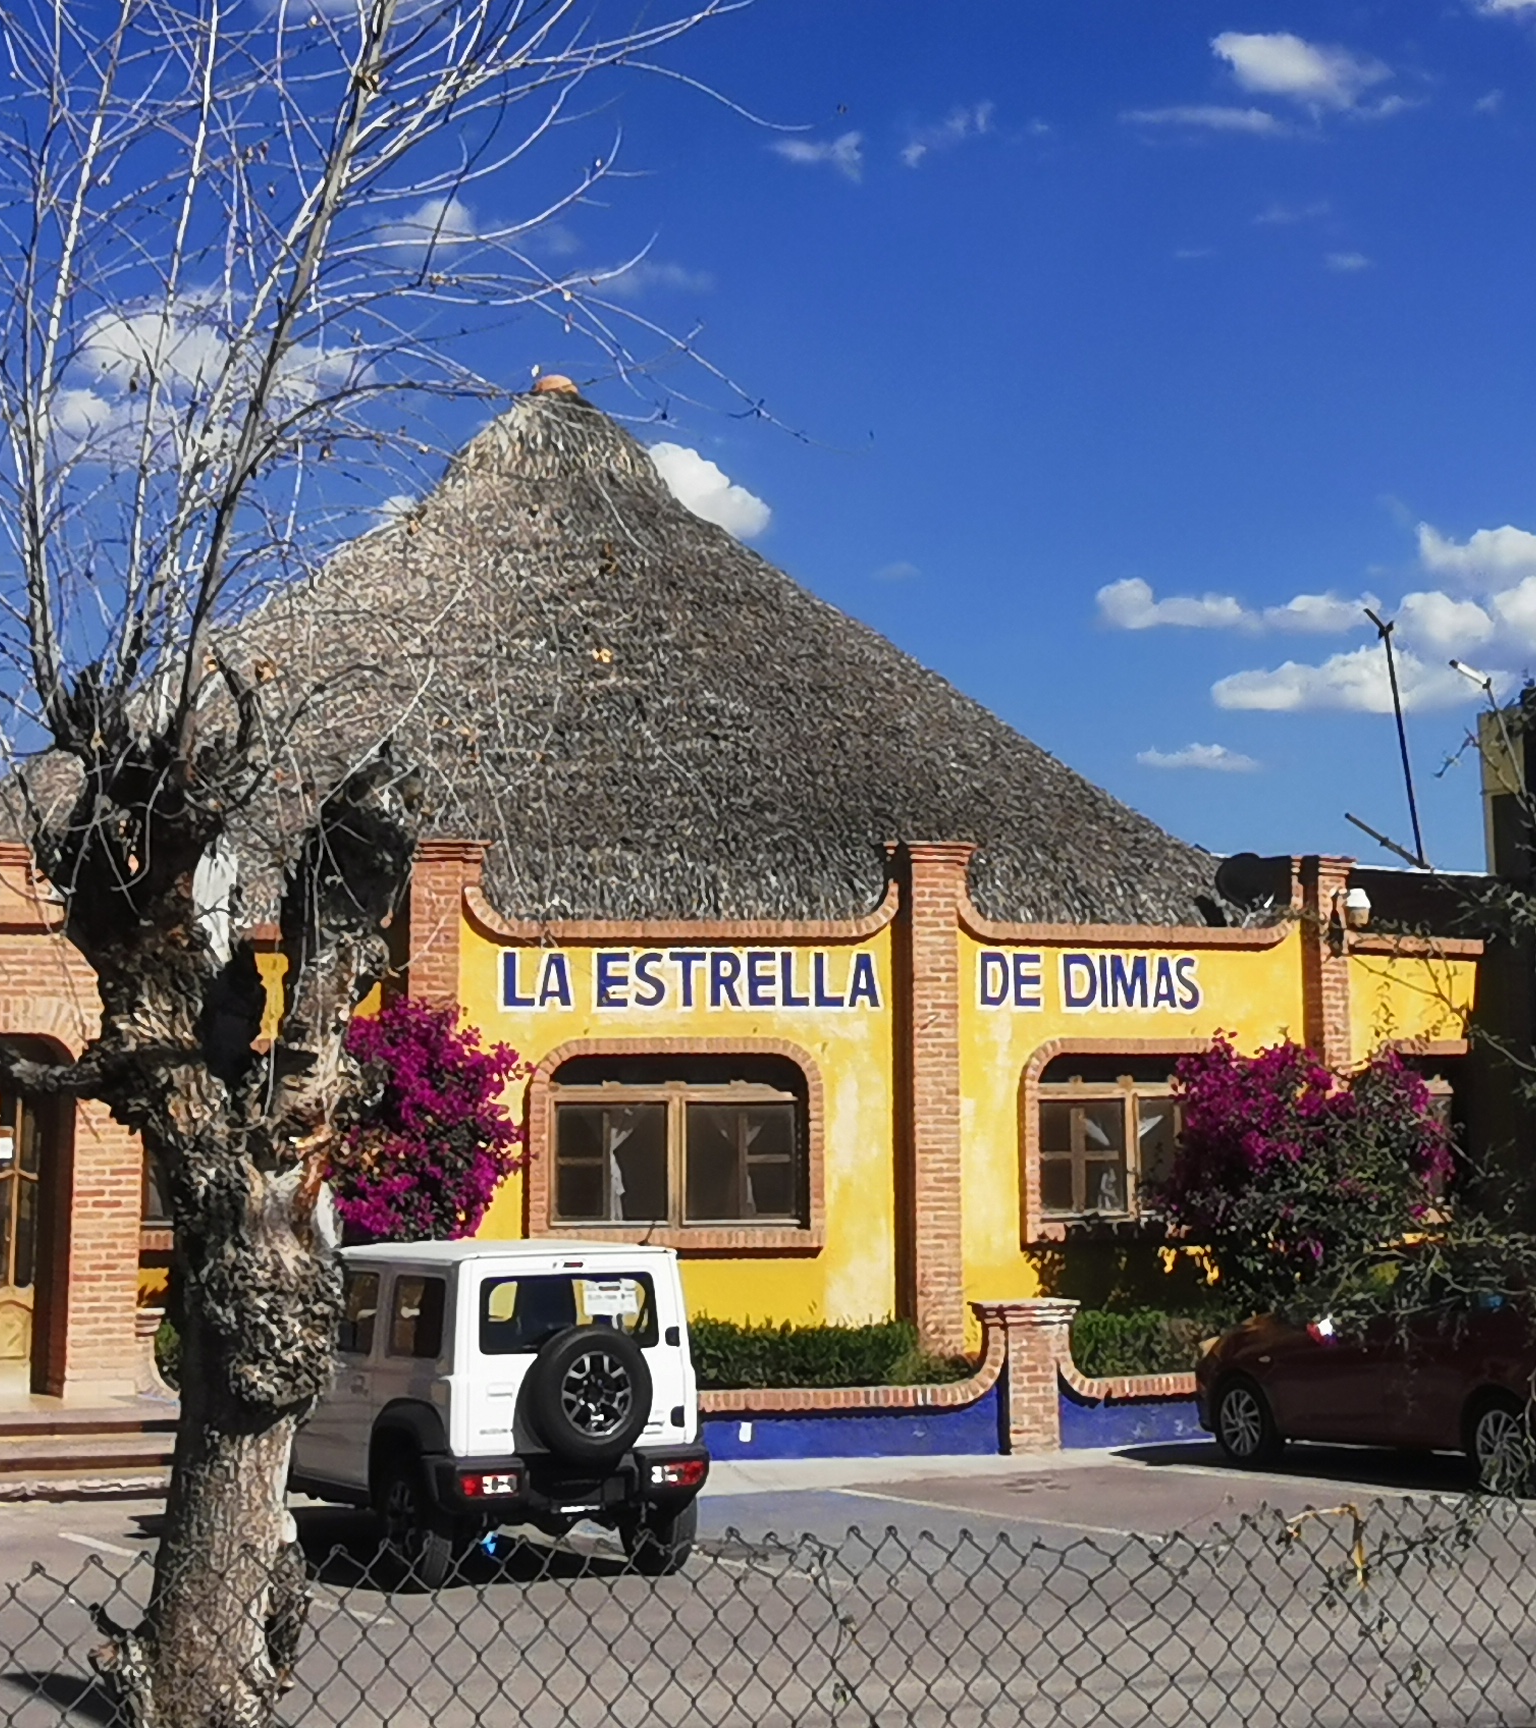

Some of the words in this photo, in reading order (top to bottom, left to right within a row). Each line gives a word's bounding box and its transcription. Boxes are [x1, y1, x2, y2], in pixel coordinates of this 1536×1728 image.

[501, 950, 573, 1009] LA
[597, 950, 881, 1010] ESTRELLA
[979, 951, 1042, 1009] DE
[1064, 951, 1202, 1010] DIMAS
